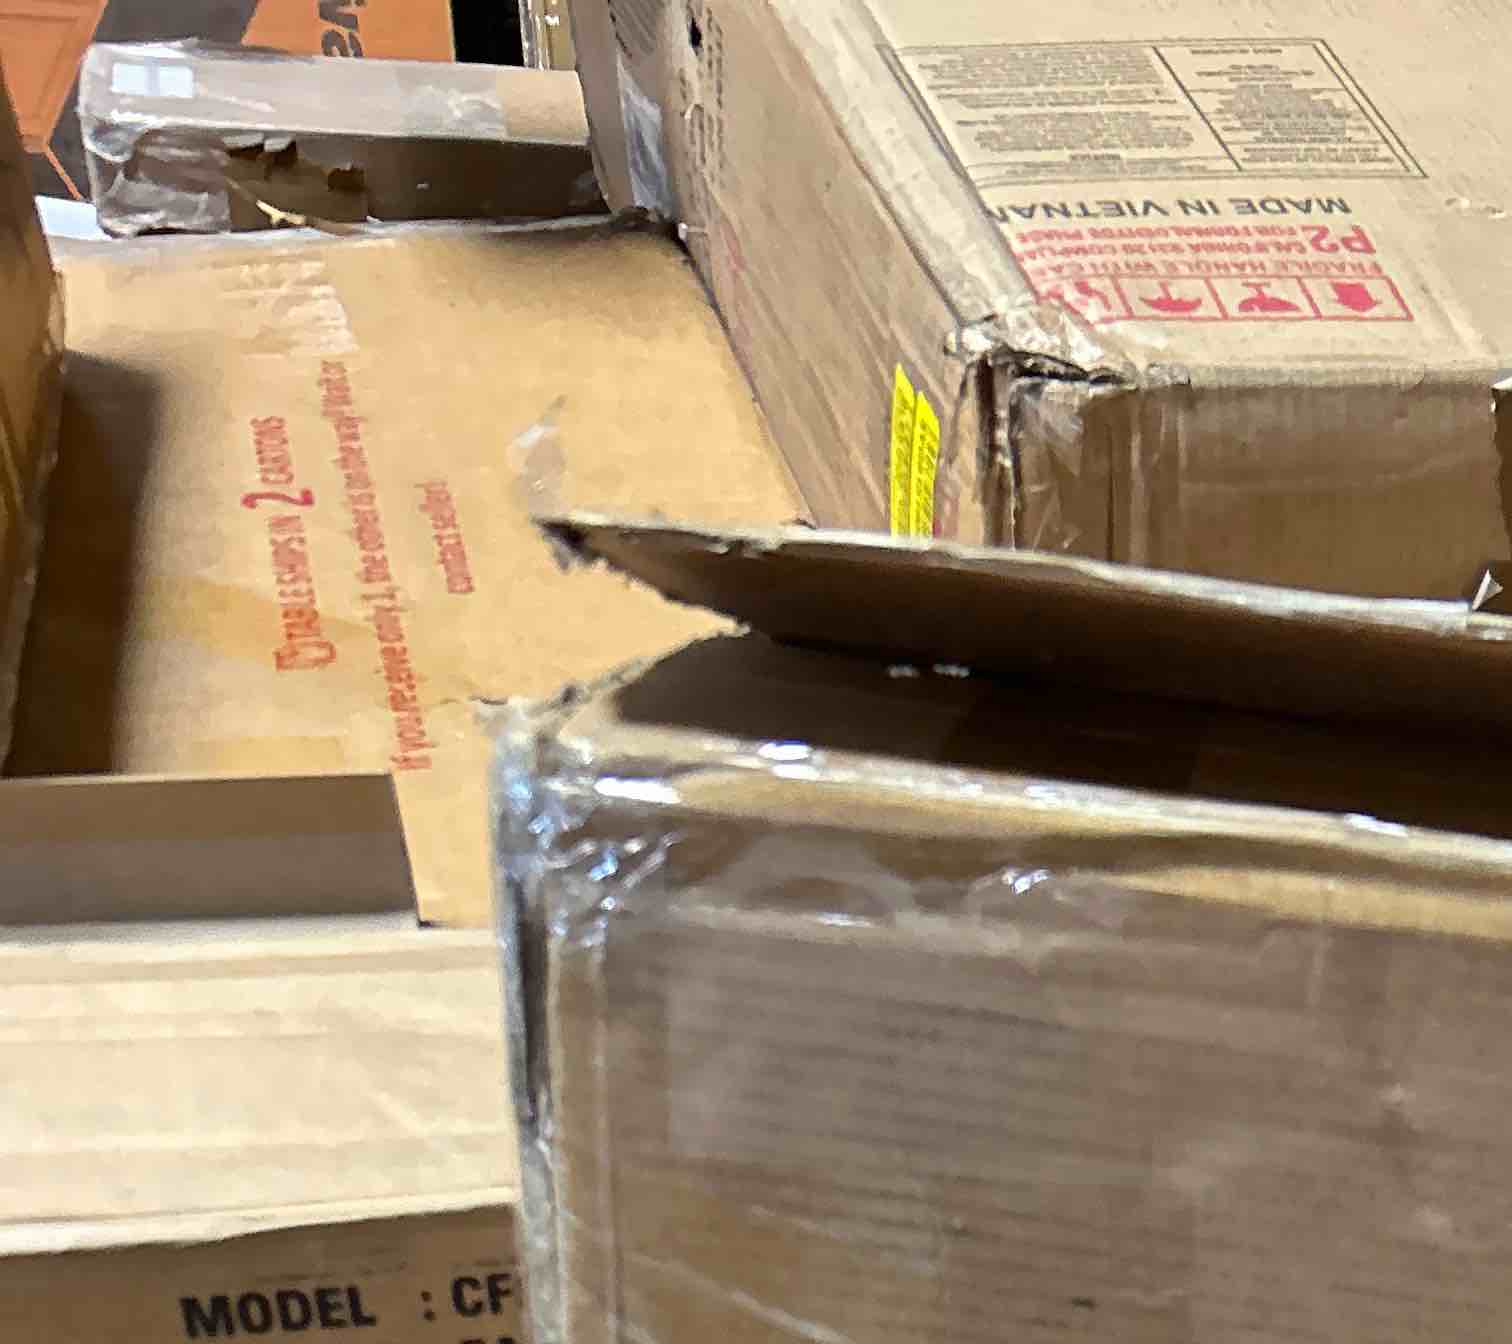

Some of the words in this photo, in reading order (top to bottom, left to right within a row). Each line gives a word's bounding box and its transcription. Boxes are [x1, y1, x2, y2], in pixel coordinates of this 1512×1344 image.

[1176, 198, 1221, 216] IN
[1230, 197, 1352, 216] MADE
[1302, 224, 1377, 255] P2
[1168, 259, 1267, 275] HANDLE
[1275, 259, 1383, 276] FRAGILE
[250, 416, 294, 484] CARTONS
[242, 488, 314, 510] 2
[179, 1284, 376, 1338] MODEL
